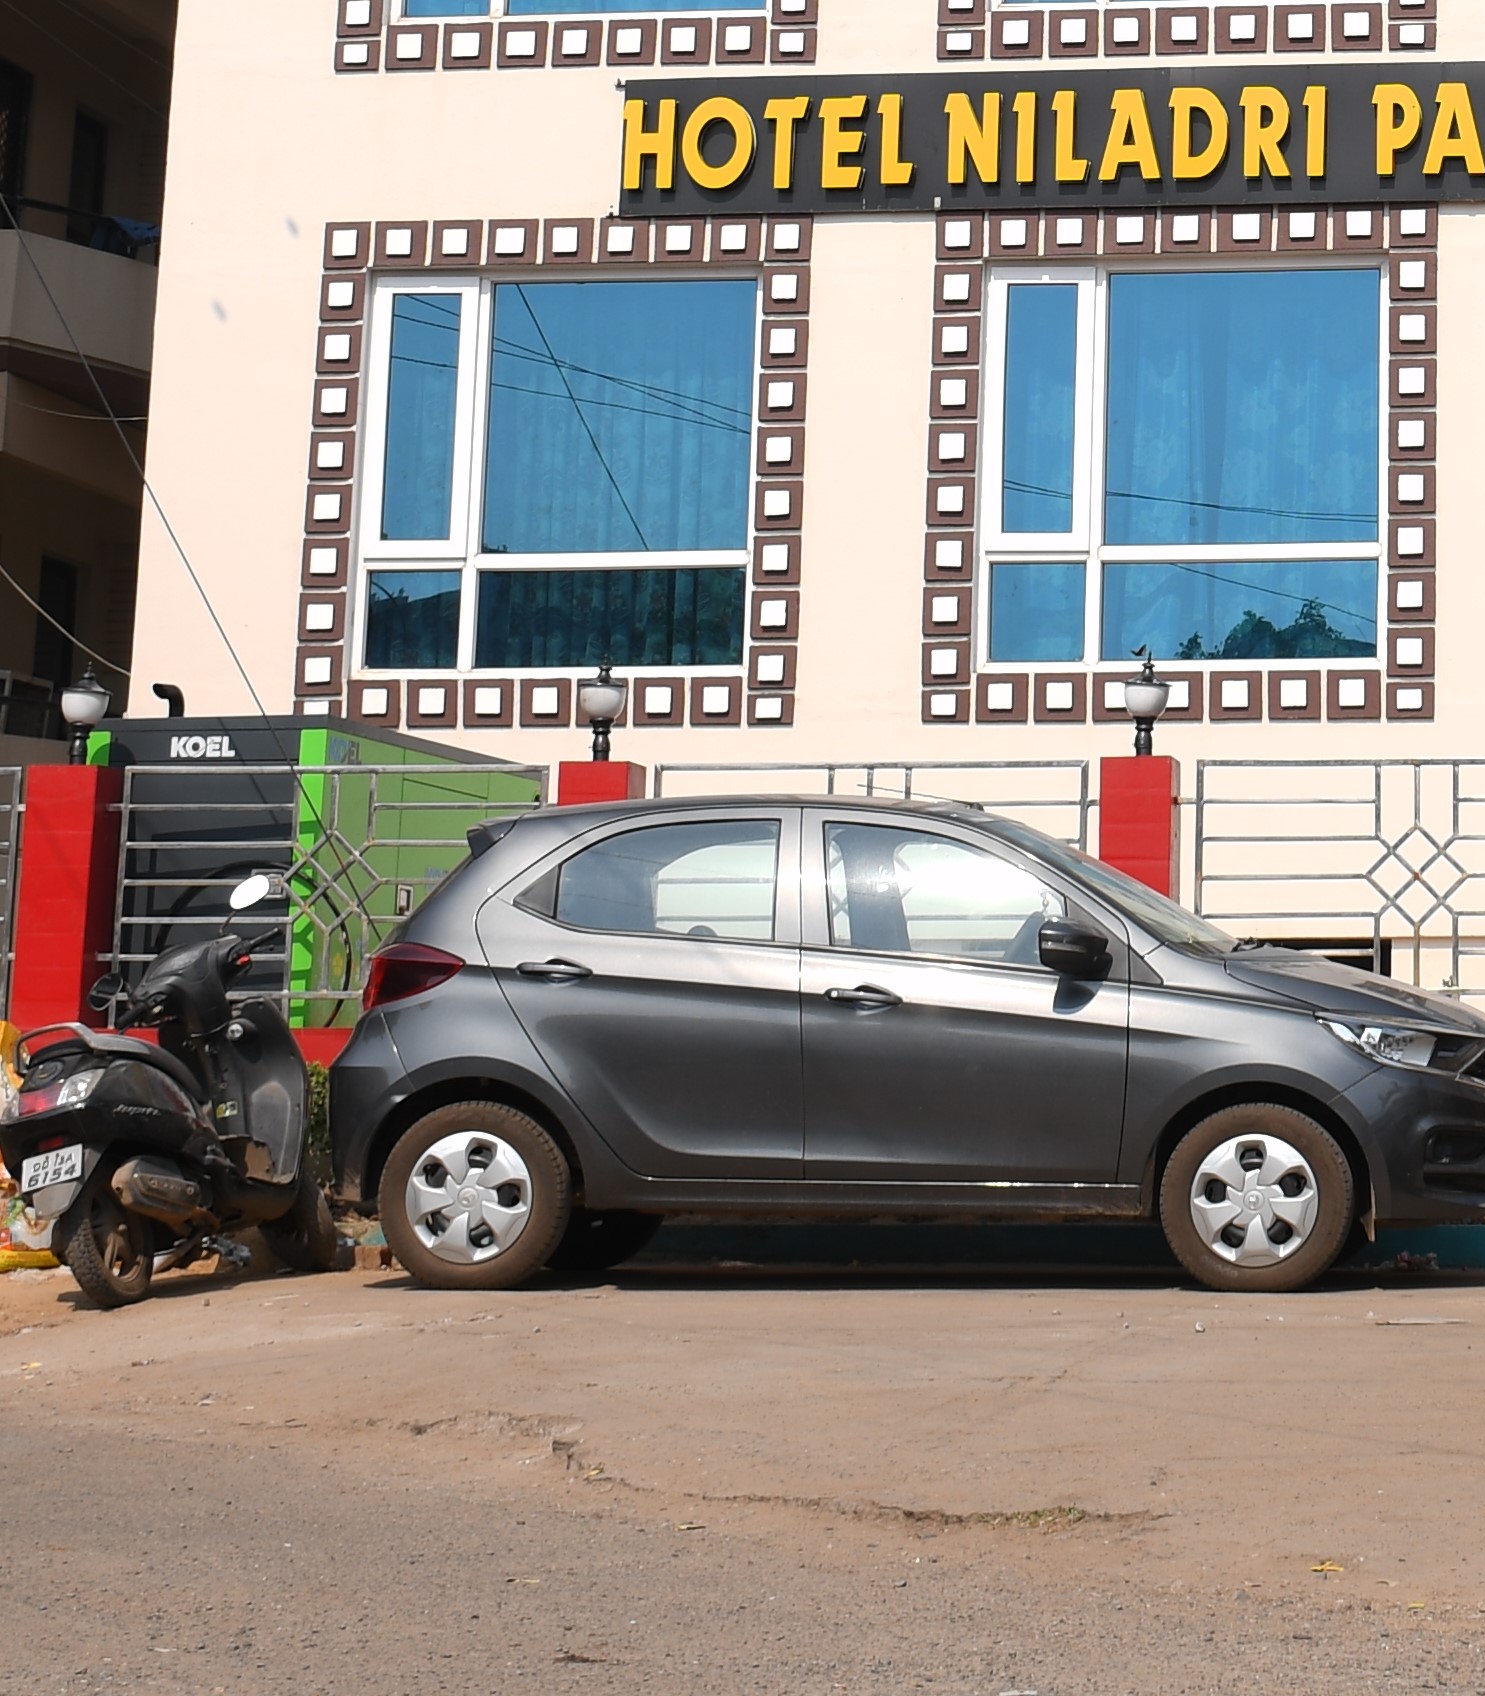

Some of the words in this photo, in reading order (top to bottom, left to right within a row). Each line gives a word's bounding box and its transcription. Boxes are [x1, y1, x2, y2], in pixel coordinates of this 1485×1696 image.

[622, 96, 914, 190] HOTEL
[944, 86, 1327, 183] NILADRI
[170, 735, 236, 758] KOEL
[27, 1163, 77, 1189] 6154
